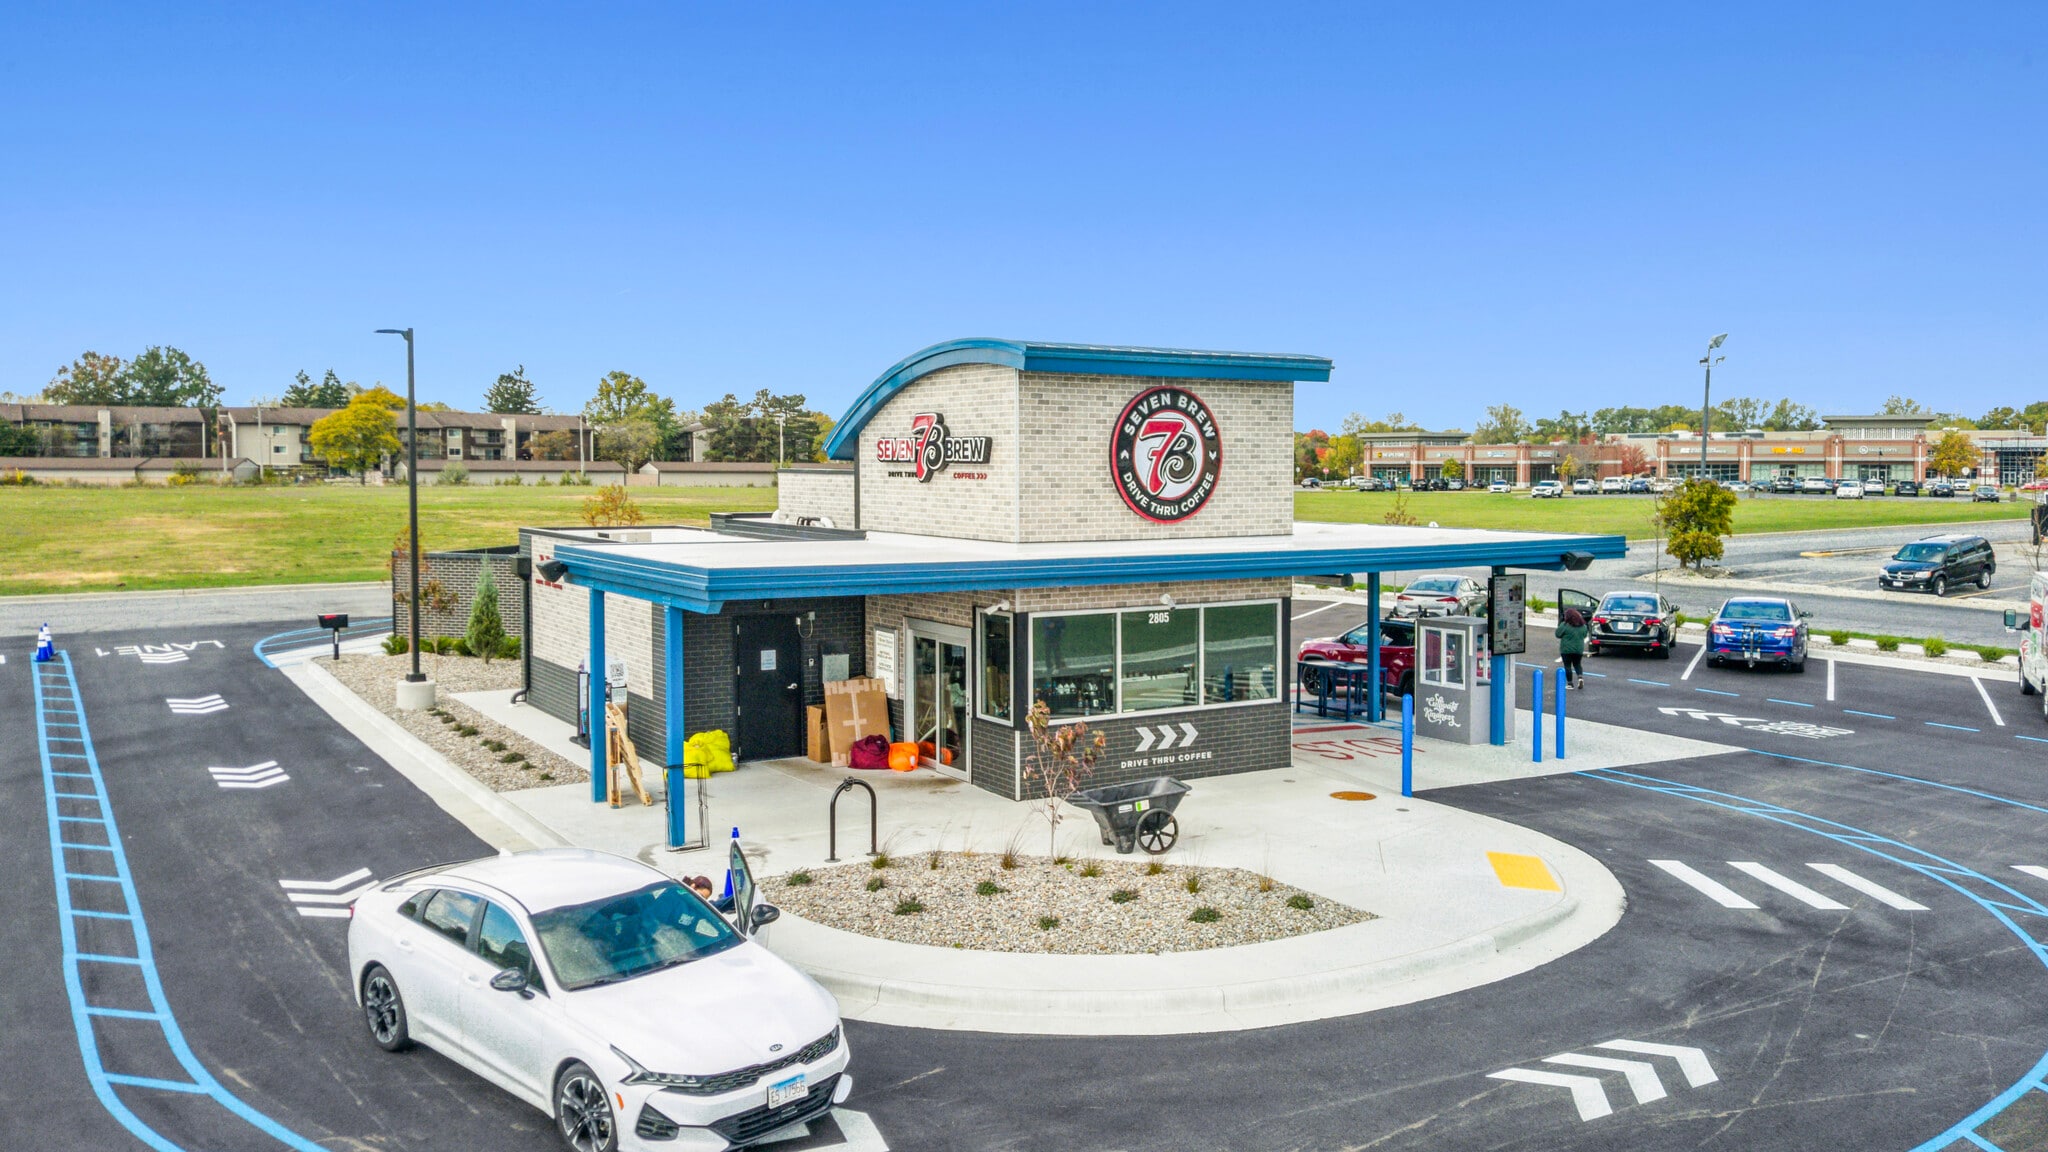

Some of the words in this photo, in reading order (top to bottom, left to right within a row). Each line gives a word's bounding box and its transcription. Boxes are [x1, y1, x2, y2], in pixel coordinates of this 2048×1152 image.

[1124, 393, 1171, 436] SEVEN
[1177, 396, 1216, 438] BREW
[877, 438, 915, 462] SEVEN
[945, 437, 986, 462] BREW
[1124, 471, 1149, 507] DRIVE
[1150, 502, 1179, 516] THRU
[1181, 473, 1214, 512] COFFEE
[1148, 612, 1170, 624] 2805
[1120, 758, 1149, 769] DRIVE
[1151, 756, 1175, 765] THRU
[1178, 751, 1212, 762] COFFEE
[1292, 737, 1426, 760] STOP
